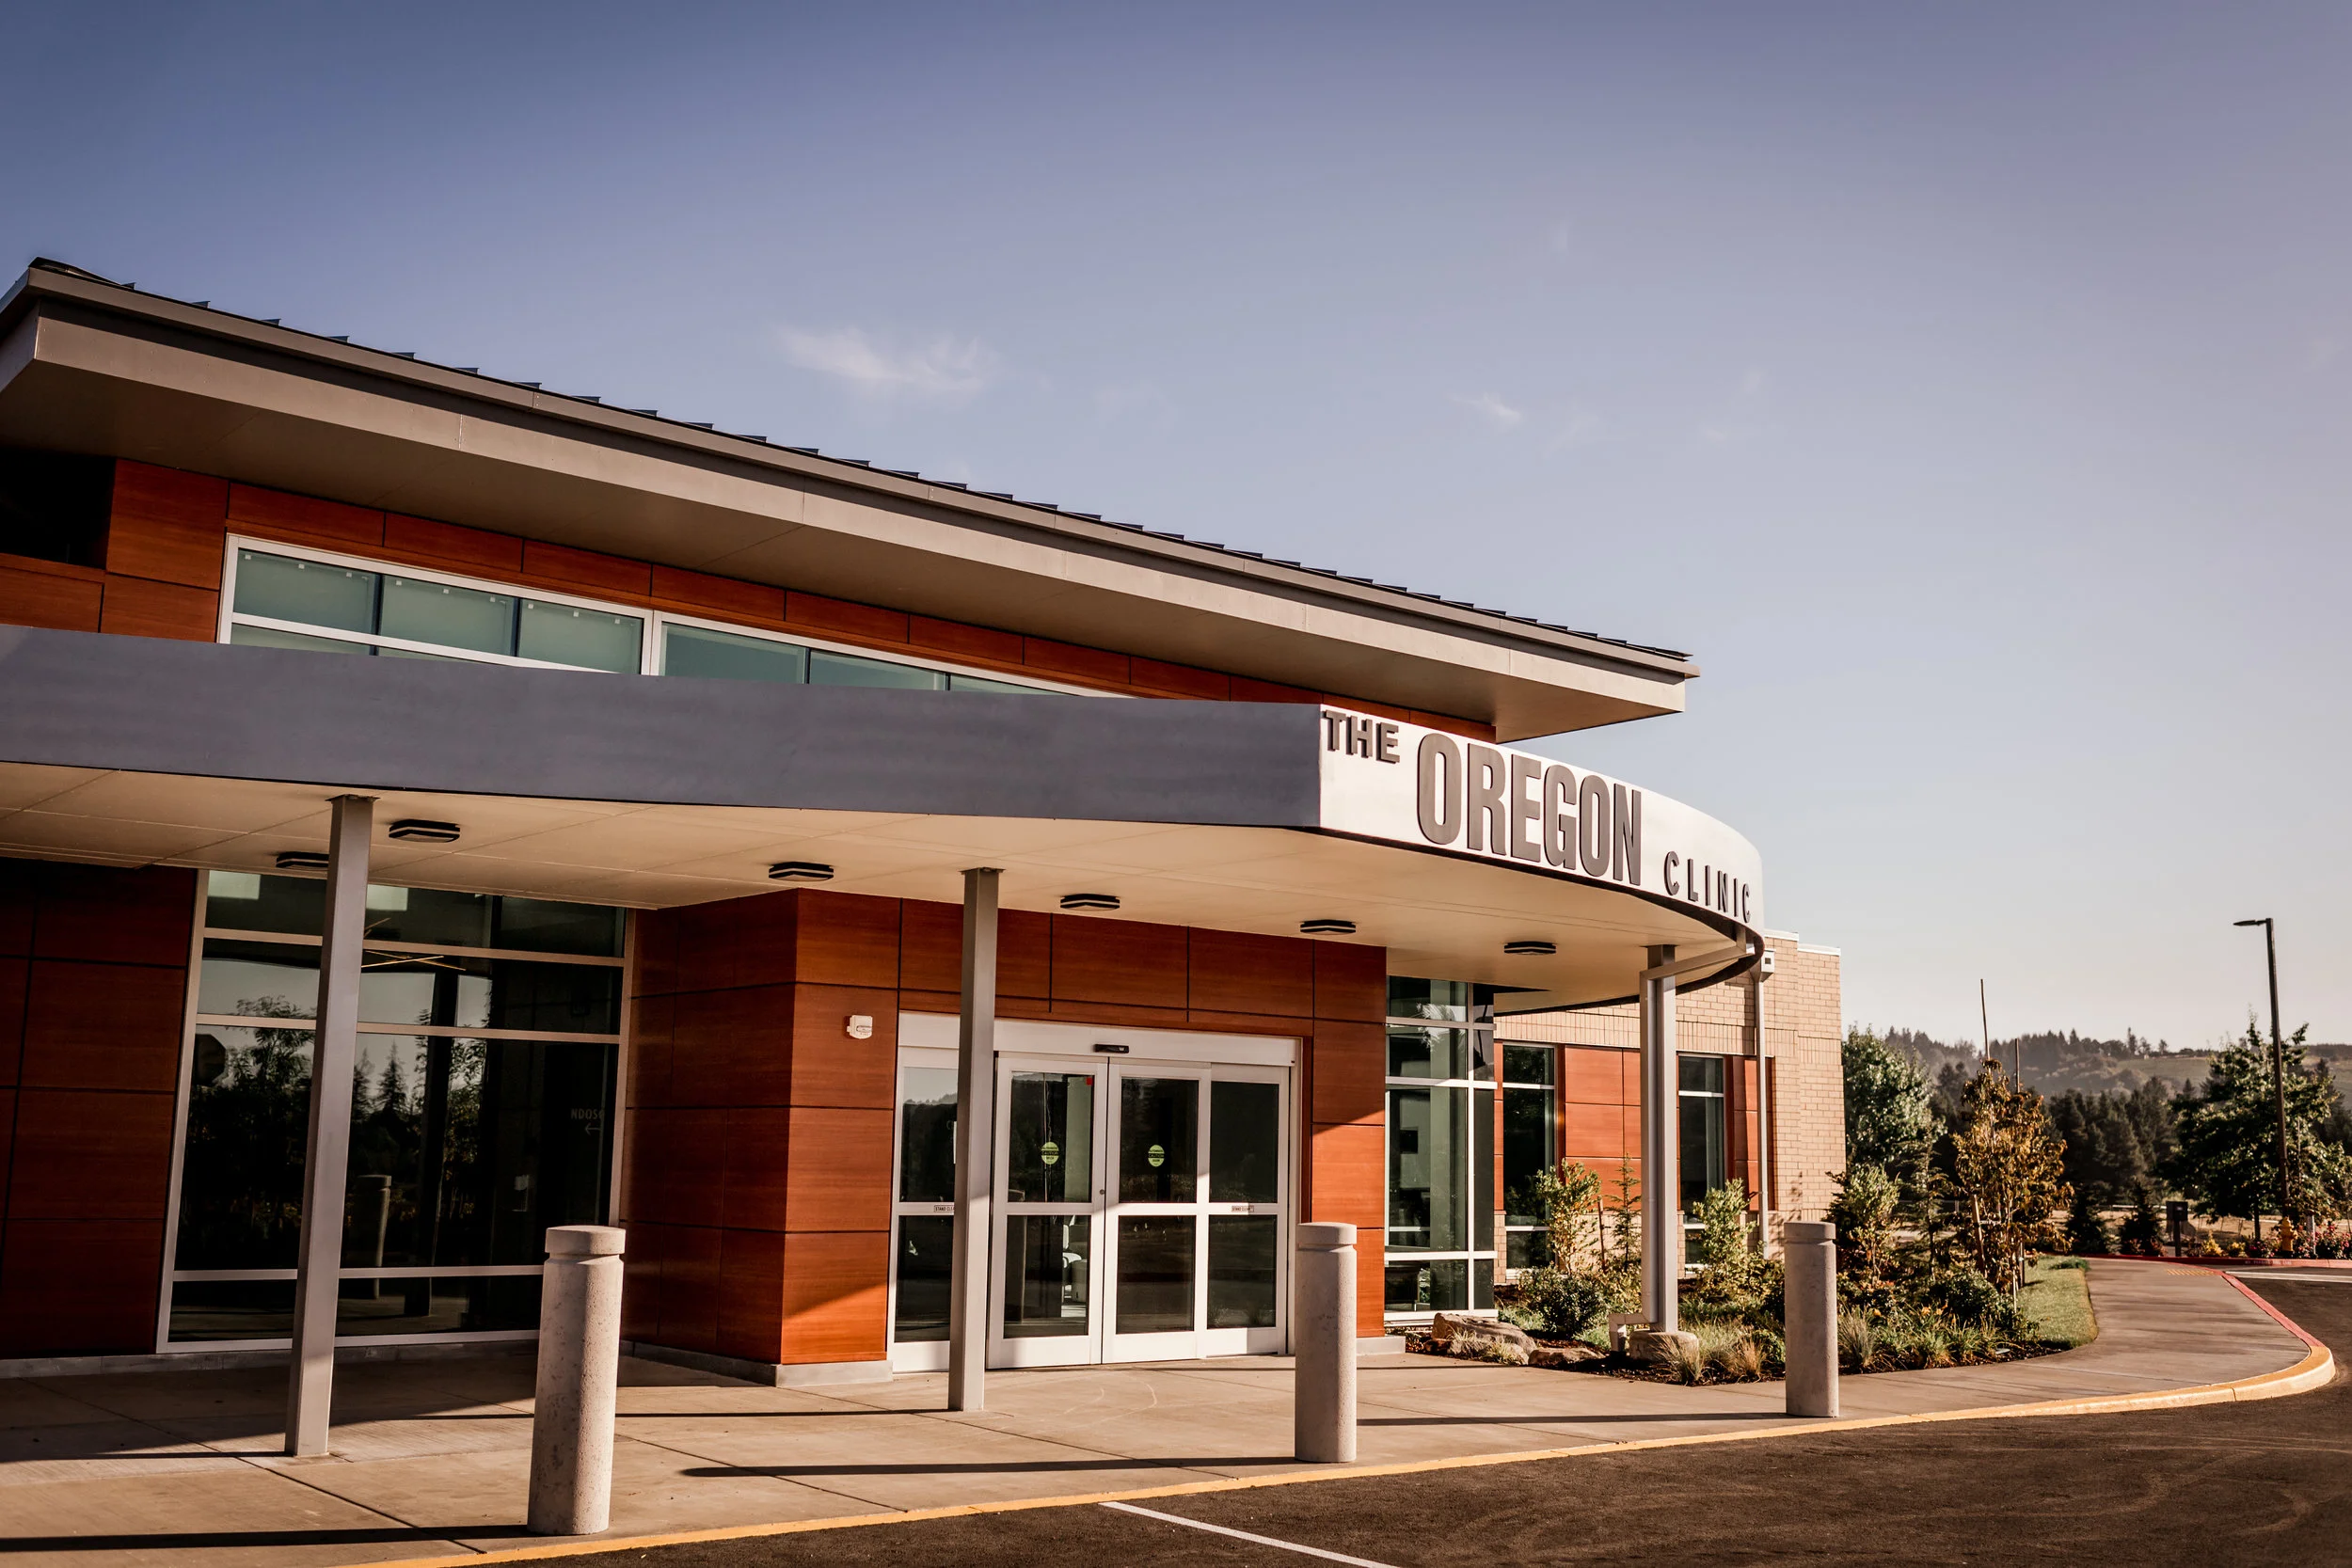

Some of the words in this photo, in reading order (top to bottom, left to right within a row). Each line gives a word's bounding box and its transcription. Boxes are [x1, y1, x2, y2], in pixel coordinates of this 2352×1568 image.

[1321, 710, 1401, 764] THE
[1417, 733, 1642, 886] OREGON
[1663, 851, 1751, 923] CLINIC
